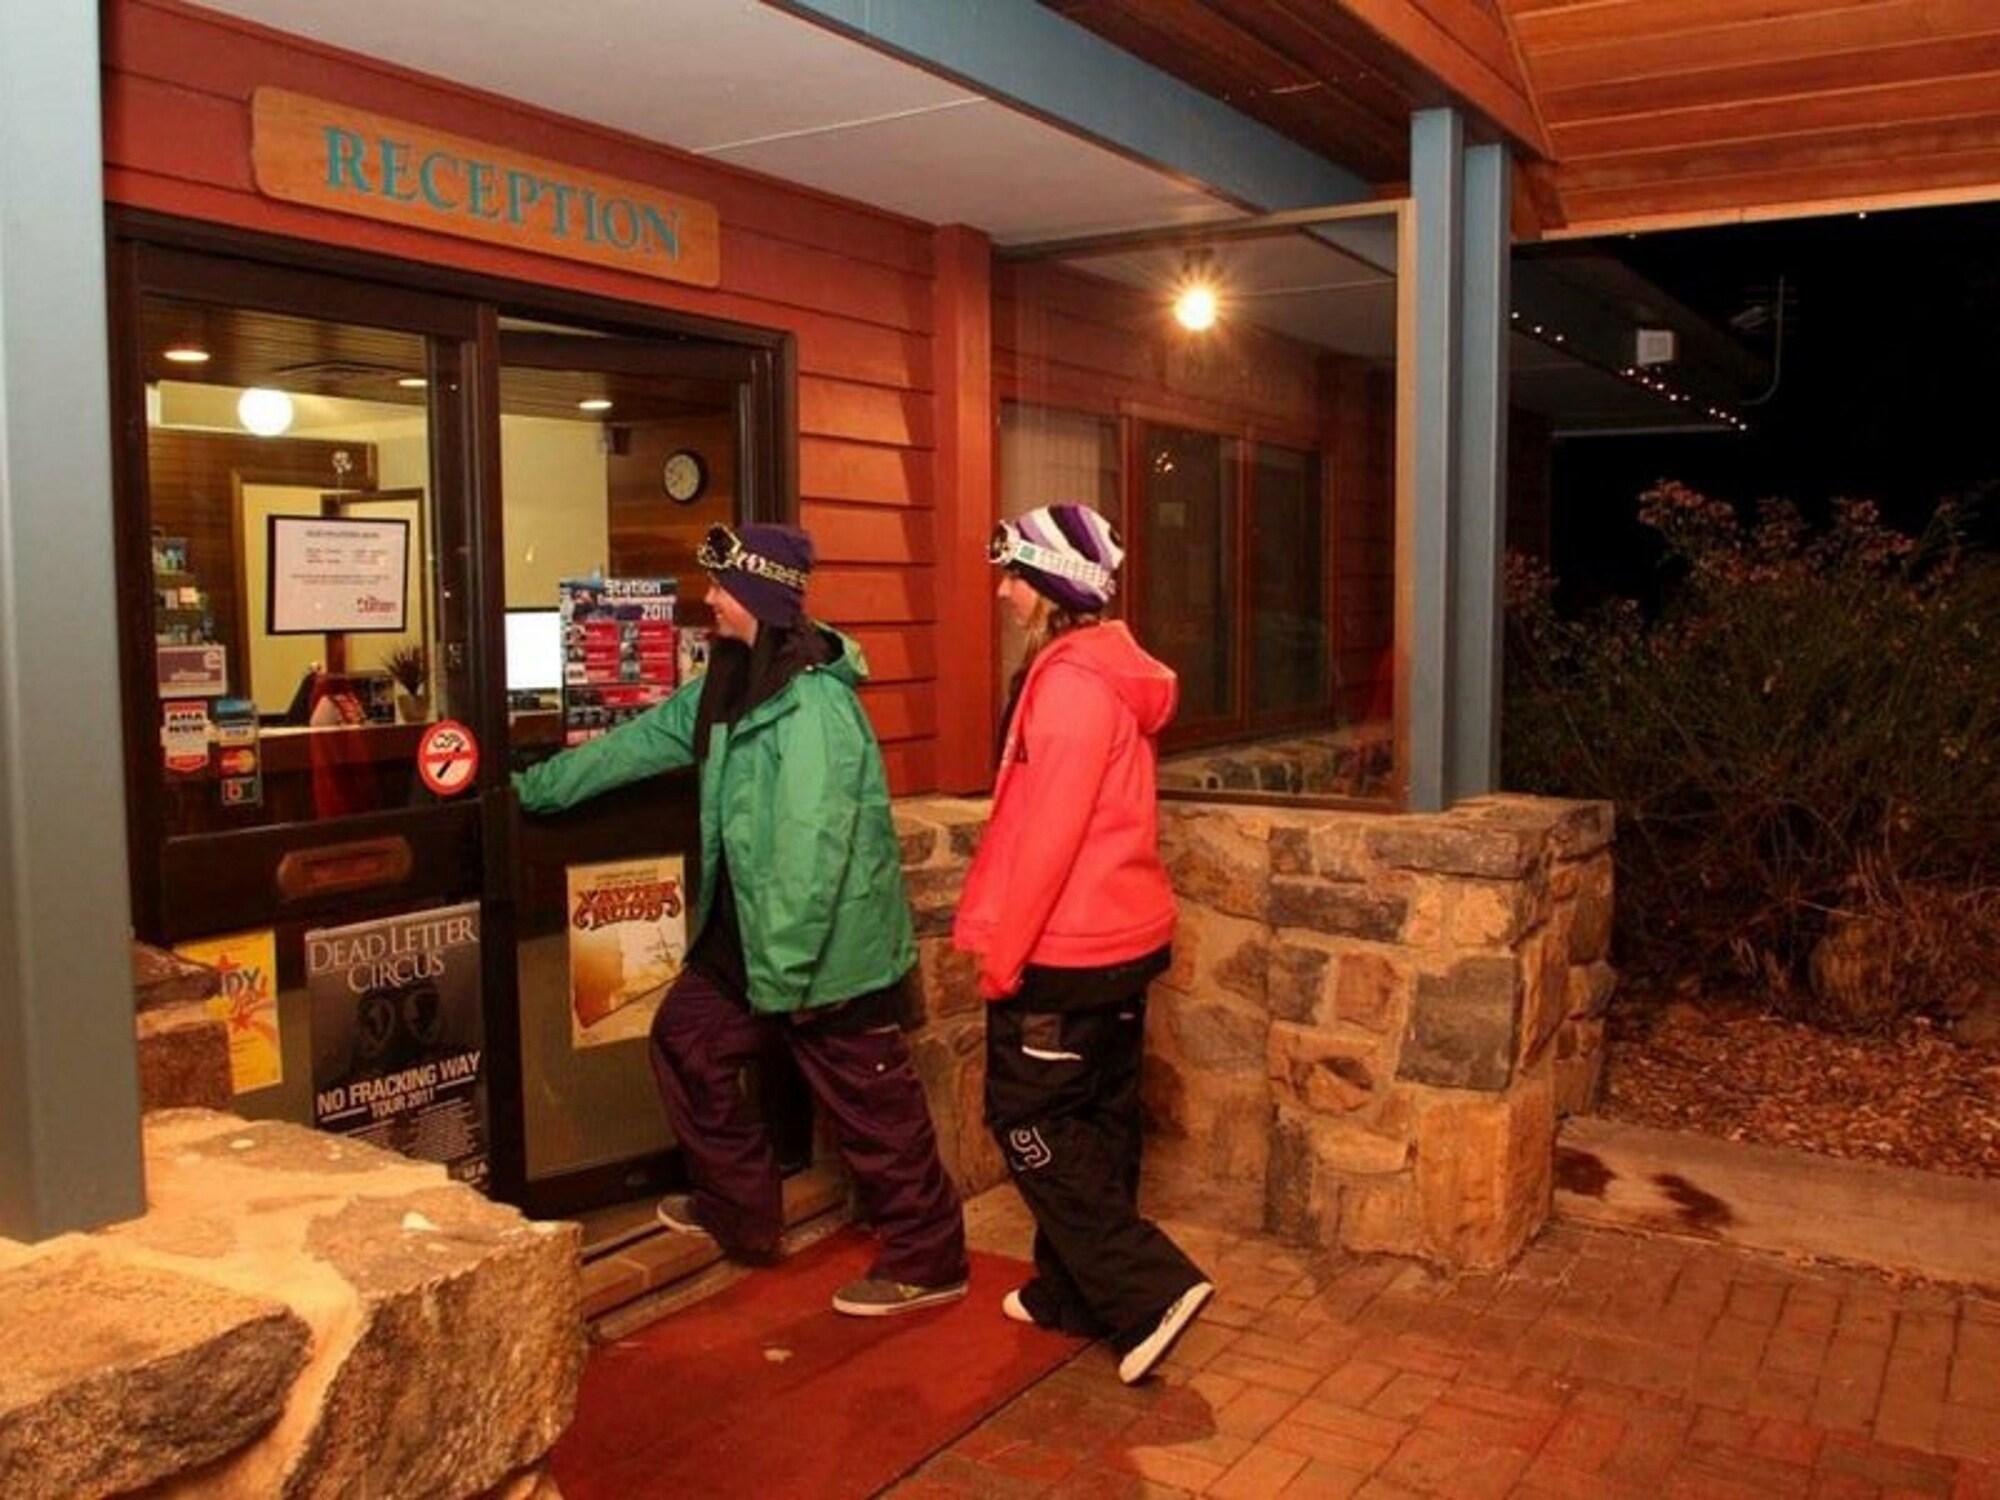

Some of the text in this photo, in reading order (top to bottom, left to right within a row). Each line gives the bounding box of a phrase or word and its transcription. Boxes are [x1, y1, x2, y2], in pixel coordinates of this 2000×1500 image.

[323, 125, 680, 261] RECEPTION
[604, 579, 662, 595] Station
[641, 603, 674, 620] 2011
[310, 916, 480, 975] DEAD LETTER
[348, 952, 445, 994] CIRCUS
[317, 1050, 482, 1116] NO FRACKING WAY
[369, 1095, 406, 1119] TOUR
